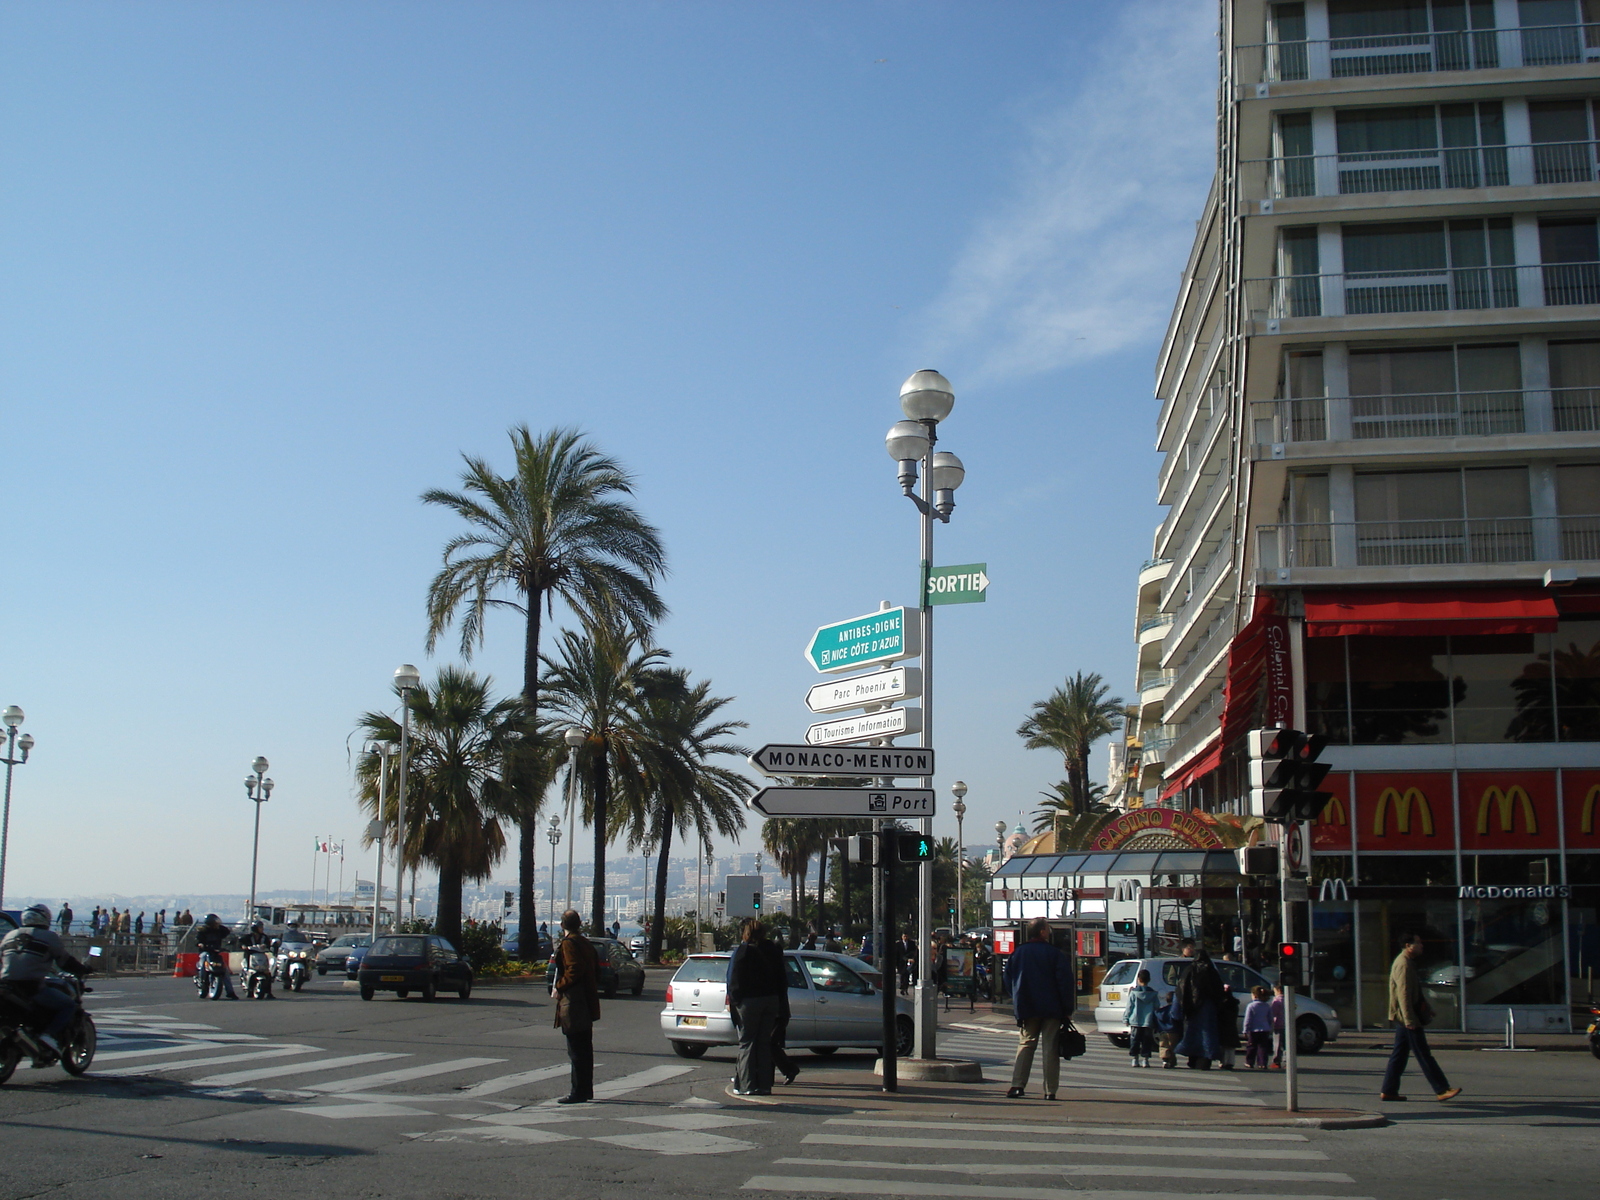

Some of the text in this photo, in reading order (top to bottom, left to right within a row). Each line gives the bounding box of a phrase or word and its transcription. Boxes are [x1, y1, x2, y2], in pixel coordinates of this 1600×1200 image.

[927, 573, 979, 594] SORTIE
[839, 617, 900, 643] ANTIBES-DIGNE
[831, 635, 900, 662] NICE CÔTE D'AZUR
[1272, 625, 1290, 690] Colonial
[833, 680, 887, 700] Parc Phoenix
[824, 715, 902, 739] Tourisme Information
[769, 752, 927, 769] MONACO-MENTON
[892, 796, 928, 810] Port
[1098, 810, 1163, 851] CASINO
[1013, 887, 1073, 901] McDonald's
[1458, 885, 1570, 899] McDonald's
